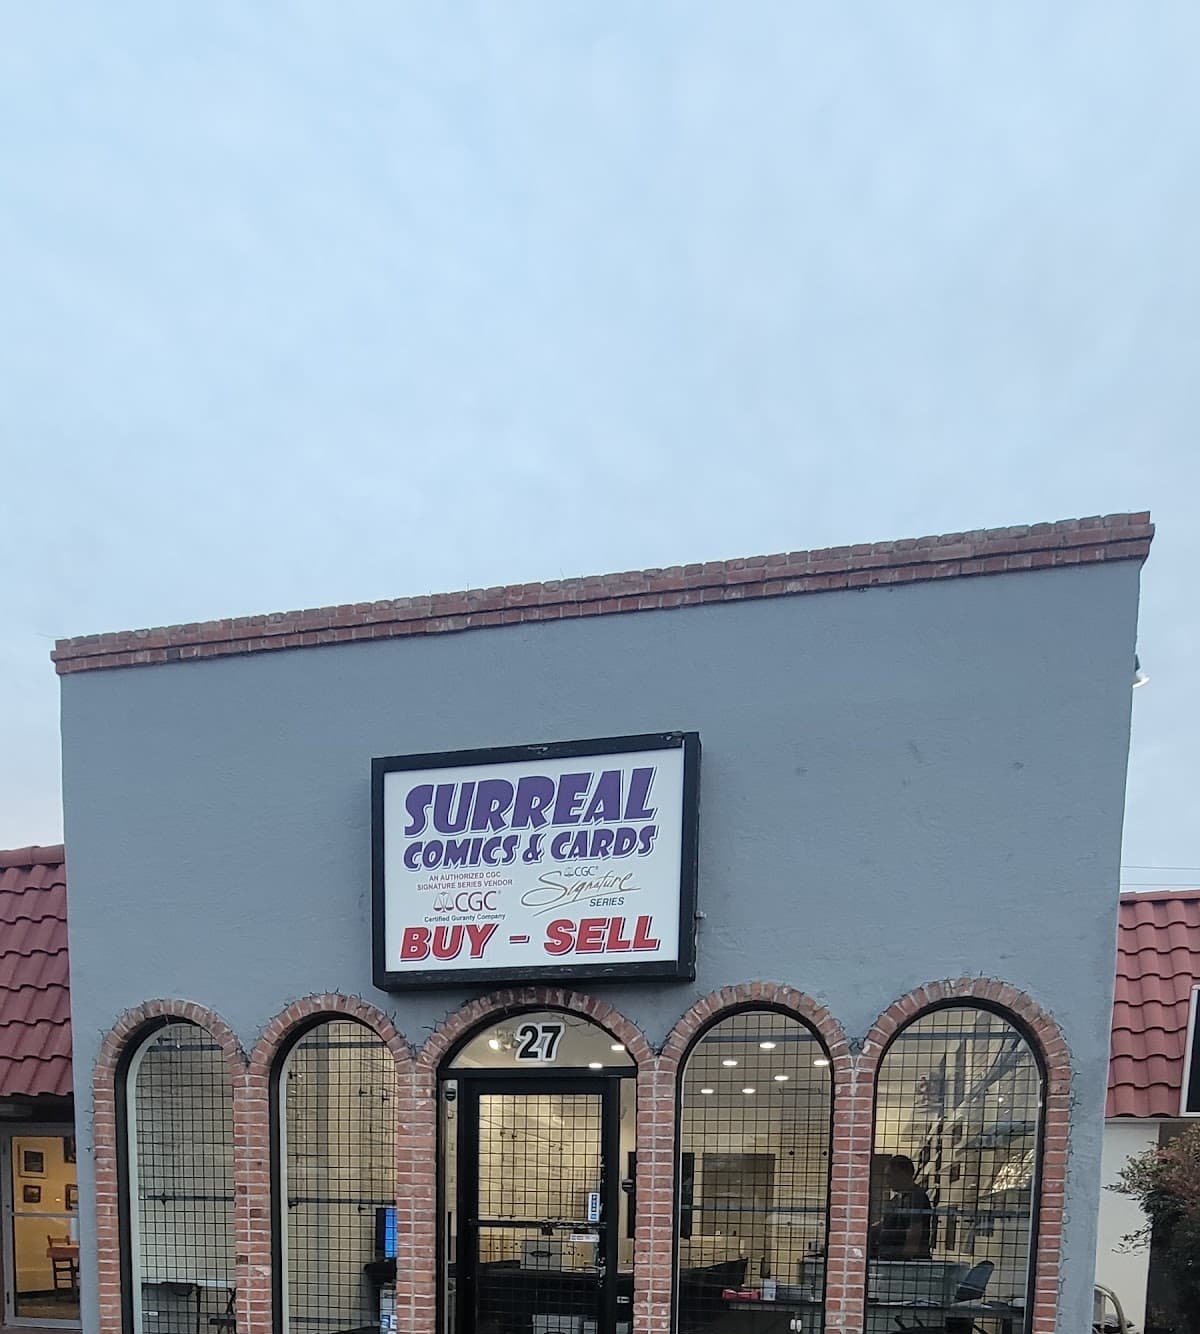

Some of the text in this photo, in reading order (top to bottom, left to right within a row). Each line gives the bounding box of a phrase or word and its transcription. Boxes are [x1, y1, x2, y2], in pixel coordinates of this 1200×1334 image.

[404, 767, 657, 837] SURREAL
[403, 825, 656, 870] COMICS & CARDS
[440, 872, 484, 880] AUTHORIZED
[574, 866, 595, 876] CGC
[417, 883, 456, 891] SIGNATURE
[484, 879, 513, 887] VENDOR
[521, 871, 641, 906] Signature
[455, 890, 497, 912] CGC
[589, 897, 625, 907] SERIES
[424, 914, 449, 923] Certified
[477, 913, 506, 921] Company
[400, 922, 499, 961] BUY
[544, 915, 661, 955] SELL
[517, 1024, 563, 1060] 27
